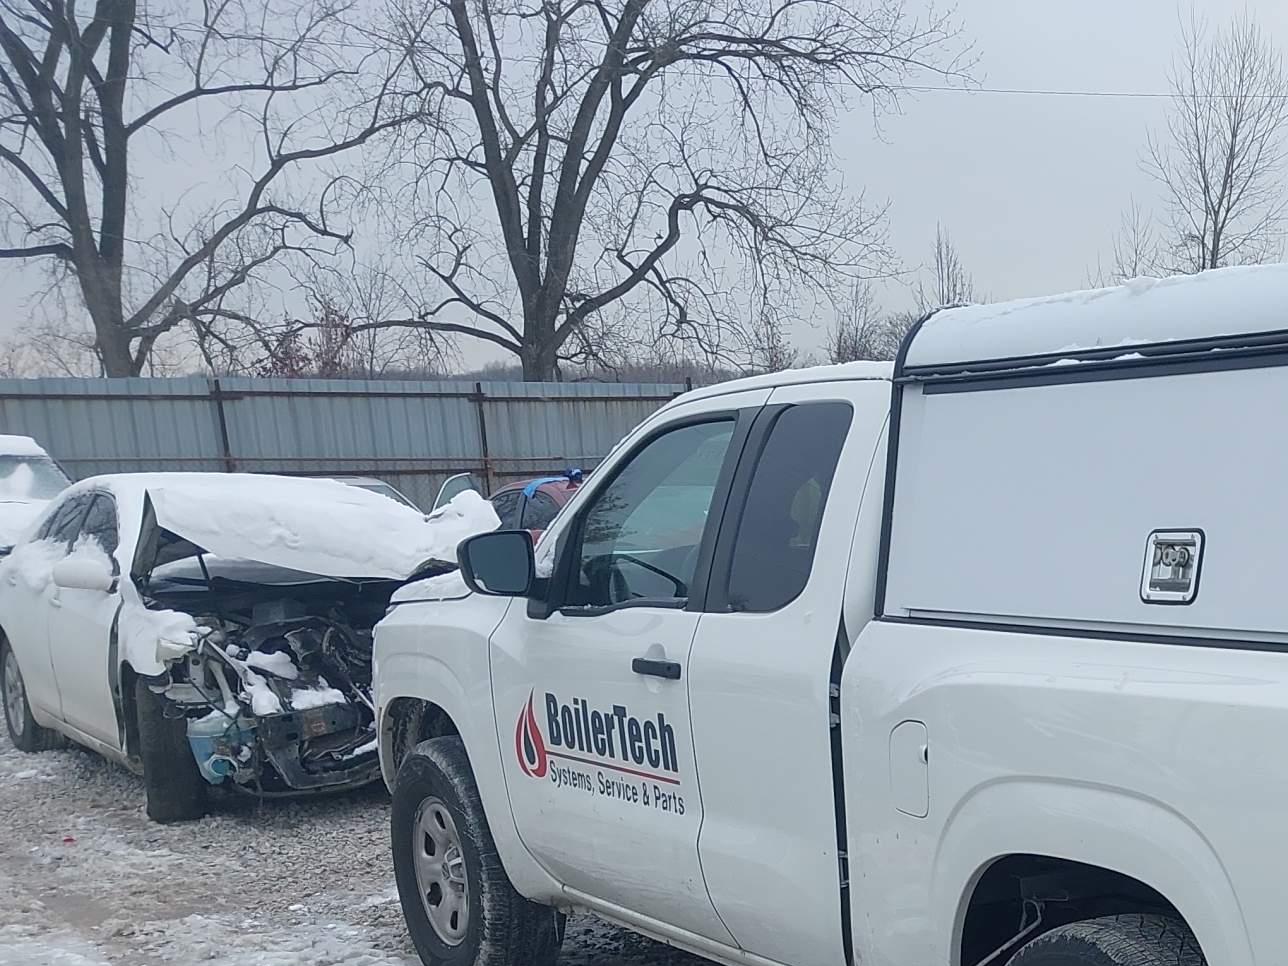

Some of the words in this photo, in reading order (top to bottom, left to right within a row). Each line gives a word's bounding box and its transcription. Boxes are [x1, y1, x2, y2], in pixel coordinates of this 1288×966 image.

[545, 693, 679, 773] BoilerTech
[549, 760, 595, 797] Systems,
[598, 771, 639, 804] Service
[642, 783, 650, 806] &
[653, 785, 686, 815] Parts
